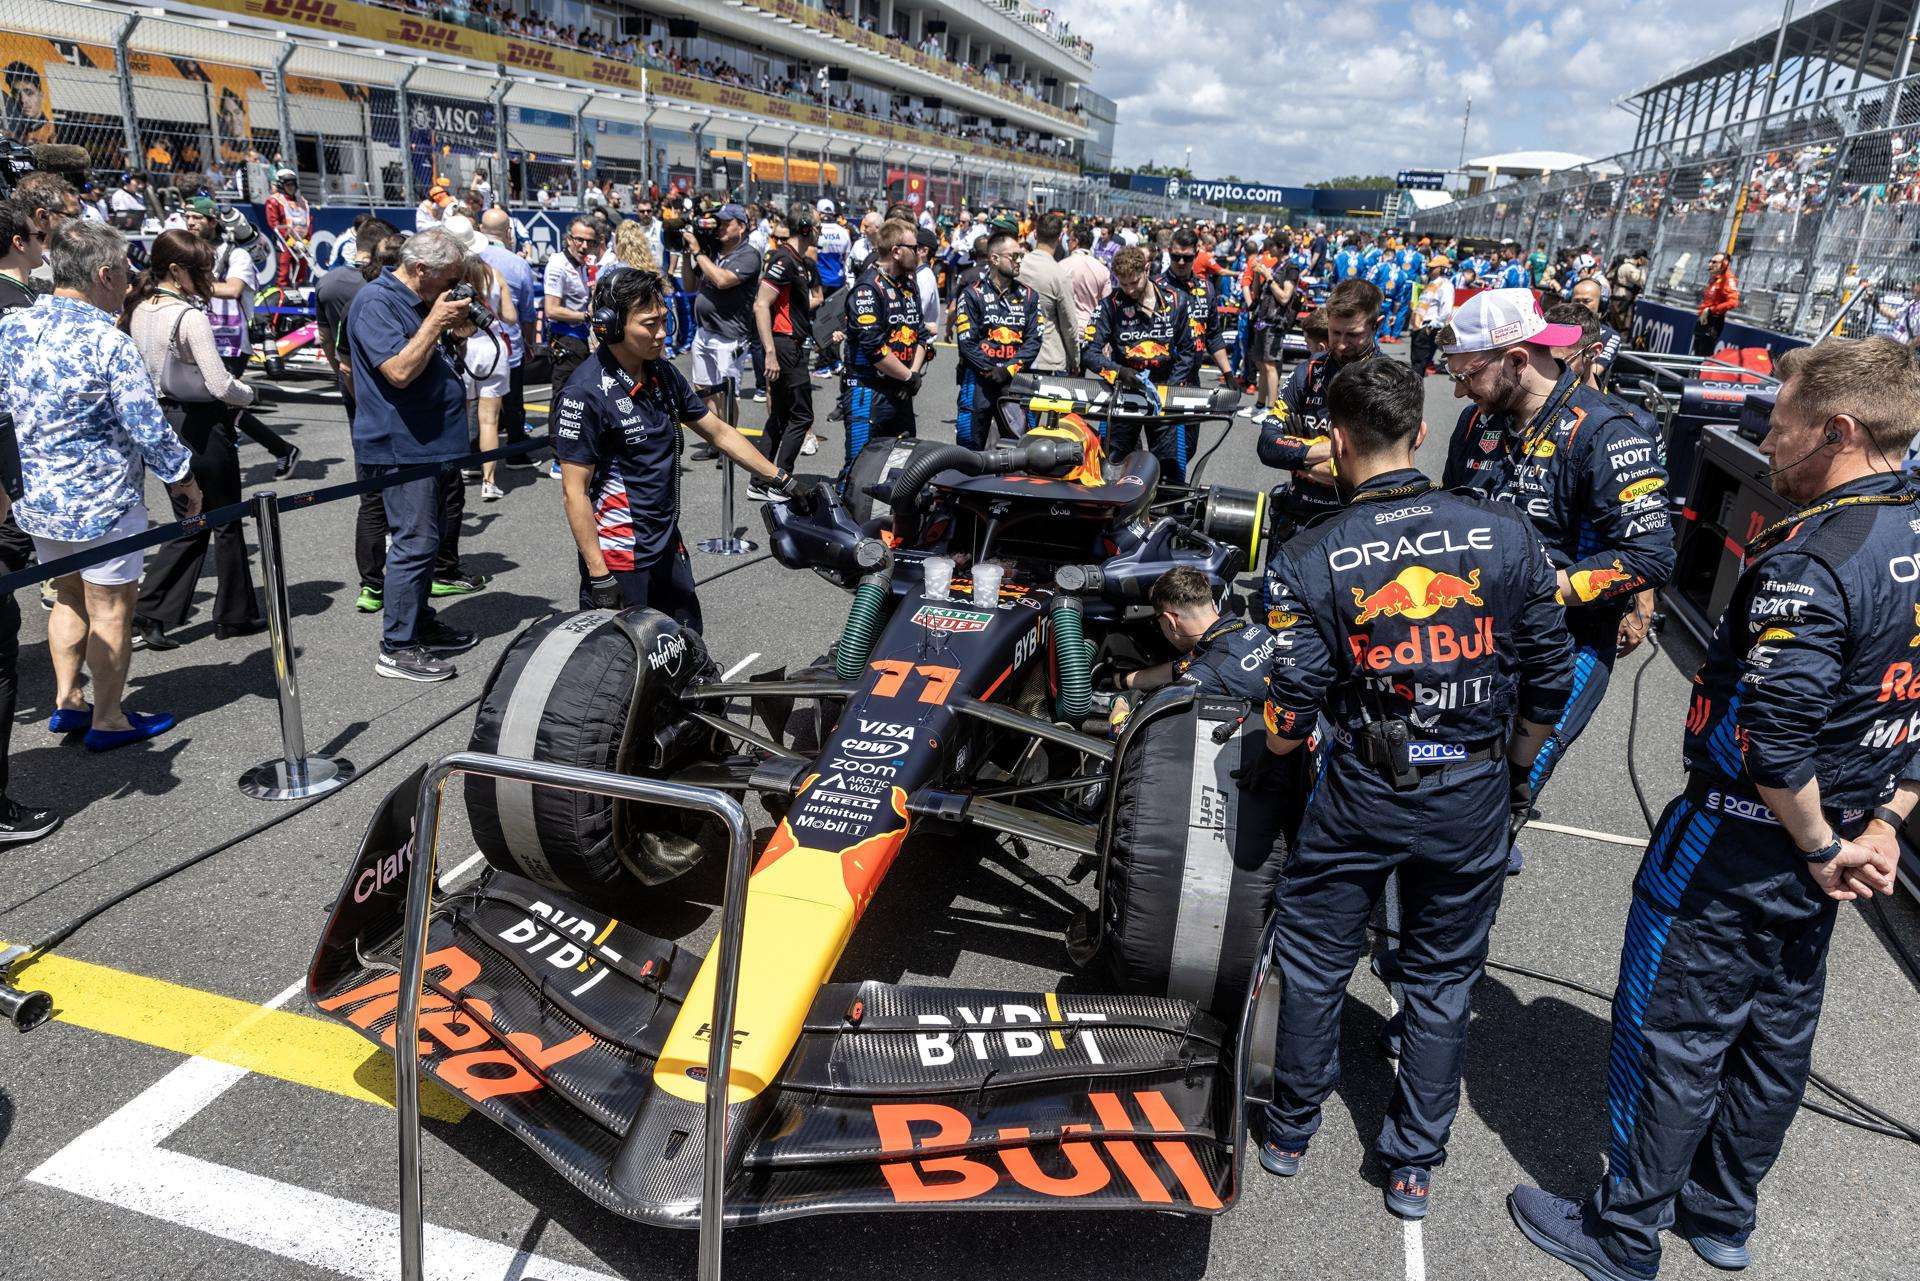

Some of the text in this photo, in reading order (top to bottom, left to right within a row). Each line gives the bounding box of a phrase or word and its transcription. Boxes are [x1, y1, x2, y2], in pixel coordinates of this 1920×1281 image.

[263, 0, 342, 27] DHL
[400, 20, 464, 52] DHL
[506, 42, 558, 71] DHL
[592, 61, 632, 85] DHL
[661, 77, 699, 98] DHL
[434, 105, 478, 134] MSC
[1406, 174, 1443, 184] crypto.com
[1189, 182, 1281, 203] crypto.com
[824, 233, 841, 241] VISA
[1120, 328, 1174, 341] ORACLE
[1702, 380, 1778, 393] ORACLE
[563, 398, 585, 411] Mobil
[625, 425, 645, 434] ORACLE
[1486, 432, 1501, 440] TAG
[1276, 438, 1302, 449] Red Bull
[1607, 435, 1650, 452] infinitum
[1632, 480, 1659, 497] RAUCH
[1375, 504, 1433, 523] sparco
[1646, 518, 1667, 530] WOLF
[1329, 527, 1494, 572] ORACLE
[1623, 575, 1647, 591] Bull
[933, 608, 981, 620] KITH
[1751, 596, 1808, 617] ROKT
[915, 614, 982, 630] HEUER
[648, 634, 687, 670] Hard Rock
[1014, 615, 1048, 671] BYBIT
[1241, 634, 1277, 672] ORAC
[1348, 624, 1421, 670] Red
[1429, 615, 1495, 663] Bull
[870, 659, 961, 706] 11
[1366, 675, 1458, 710] Mobil
[857, 719, 915, 741] VISA
[841, 738, 894, 756] CDW
[1408, 743, 1466, 763] parco
[847, 776, 891, 789] ARCTIC
[850, 784, 886, 796] WOLF
[810, 789, 881, 811] PIRELLI
[1200, 784, 1215, 826] Left
[1707, 790, 1780, 822] sparc
[803, 802, 873, 823] infinitum
[1213, 789, 1229, 843] Front
[795, 813, 848, 834] Mobil
[499, 900, 623, 998] BYBIT
[316, 945, 598, 1103] Red
[695, 1022, 750, 1045] HC
[916, 992, 1107, 1068] BYBIT
[872, 1091, 1224, 1209] Bull
